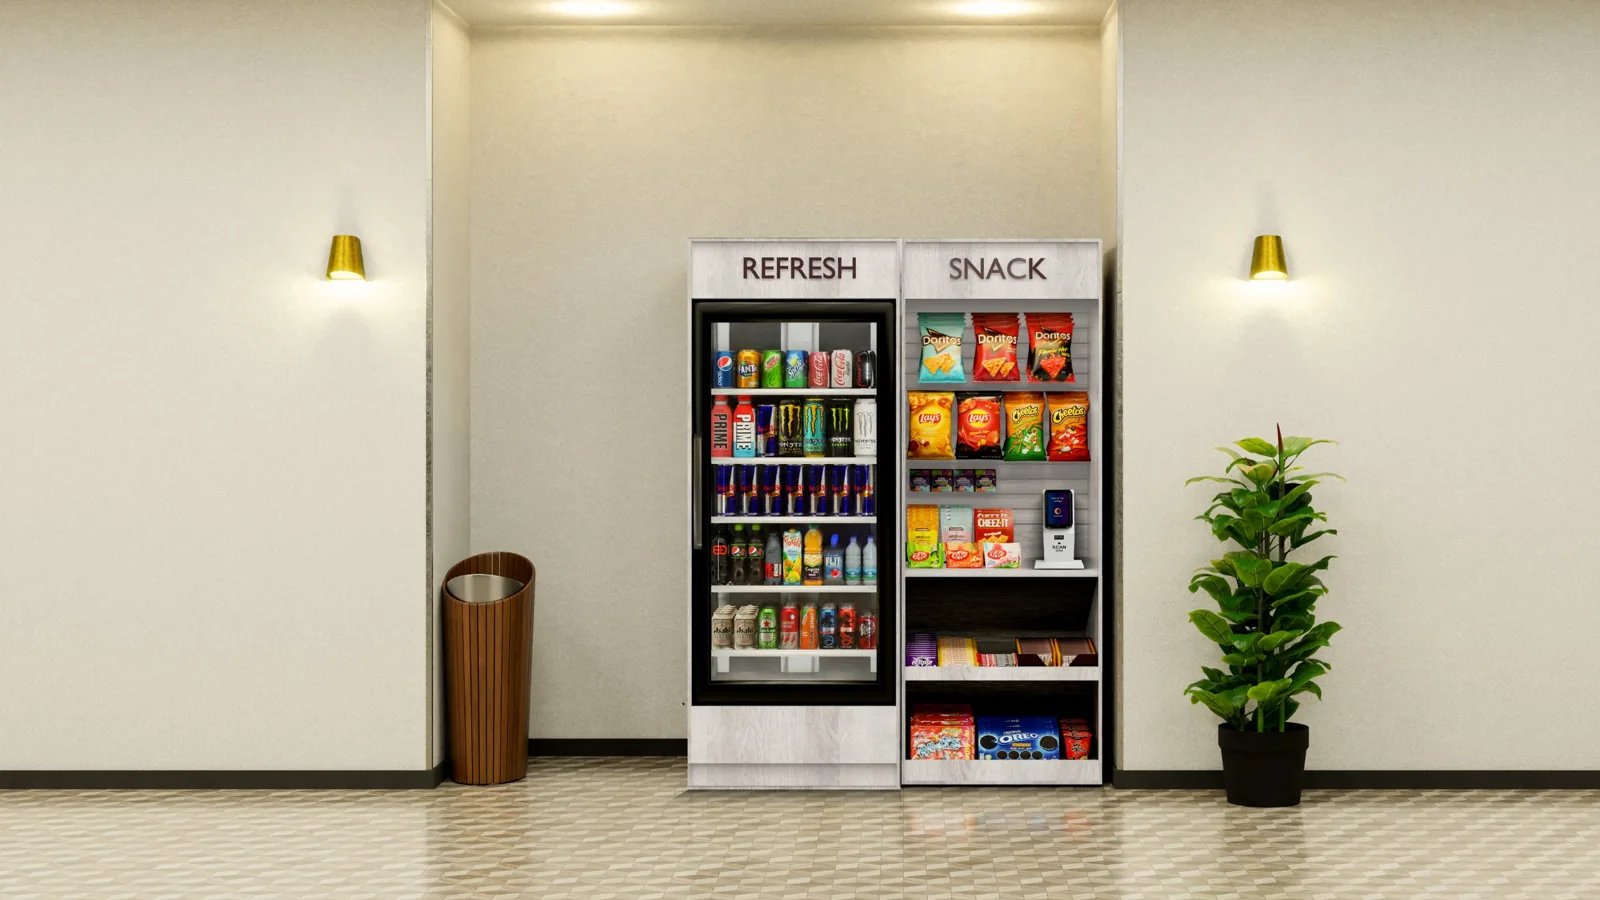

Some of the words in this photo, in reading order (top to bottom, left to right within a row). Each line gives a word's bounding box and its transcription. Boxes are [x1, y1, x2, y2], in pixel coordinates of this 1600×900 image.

[743, 257, 857, 280] REFRESH
[950, 257, 1047, 280] SNACK
[923, 336, 962, 346] Doritos
[978, 334, 1017, 345] Doritos
[1035, 331, 1071, 341] Doritos
[1012, 405, 1038, 423] Cheetos
[1052, 406, 1086, 424] Cheetos
[714, 413, 728, 449] PRIME
[736, 414, 752, 450] PRIME
[825, 556, 840, 566] FIJI
[999, 733, 1038, 744] OREO
